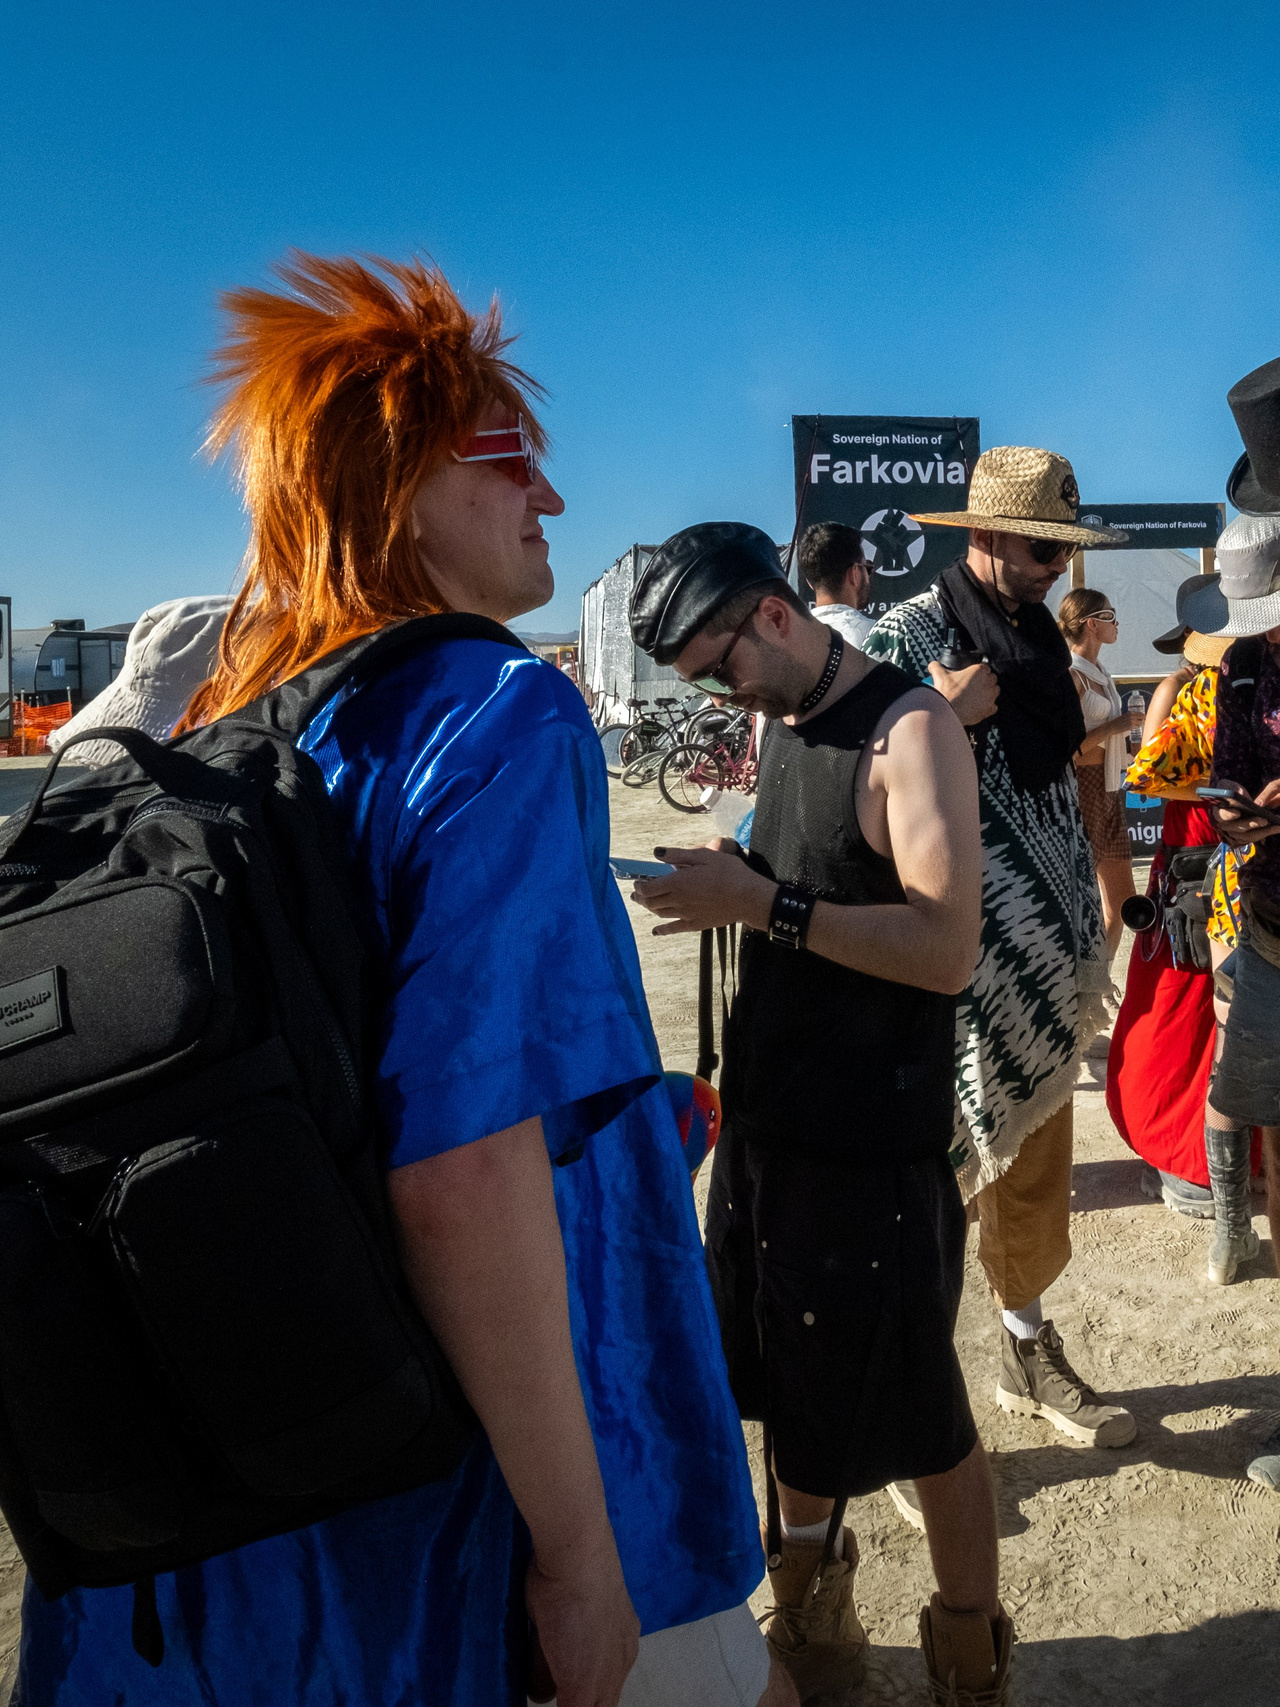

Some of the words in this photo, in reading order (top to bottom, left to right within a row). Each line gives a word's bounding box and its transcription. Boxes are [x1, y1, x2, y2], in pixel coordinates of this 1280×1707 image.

[832, 433, 890, 446] Sovereign
[892, 434, 929, 445] Nation
[930, 434, 943, 445] of
[1109, 522, 1145, 531] Sovereign
[1169, 521, 1177, 529] of
